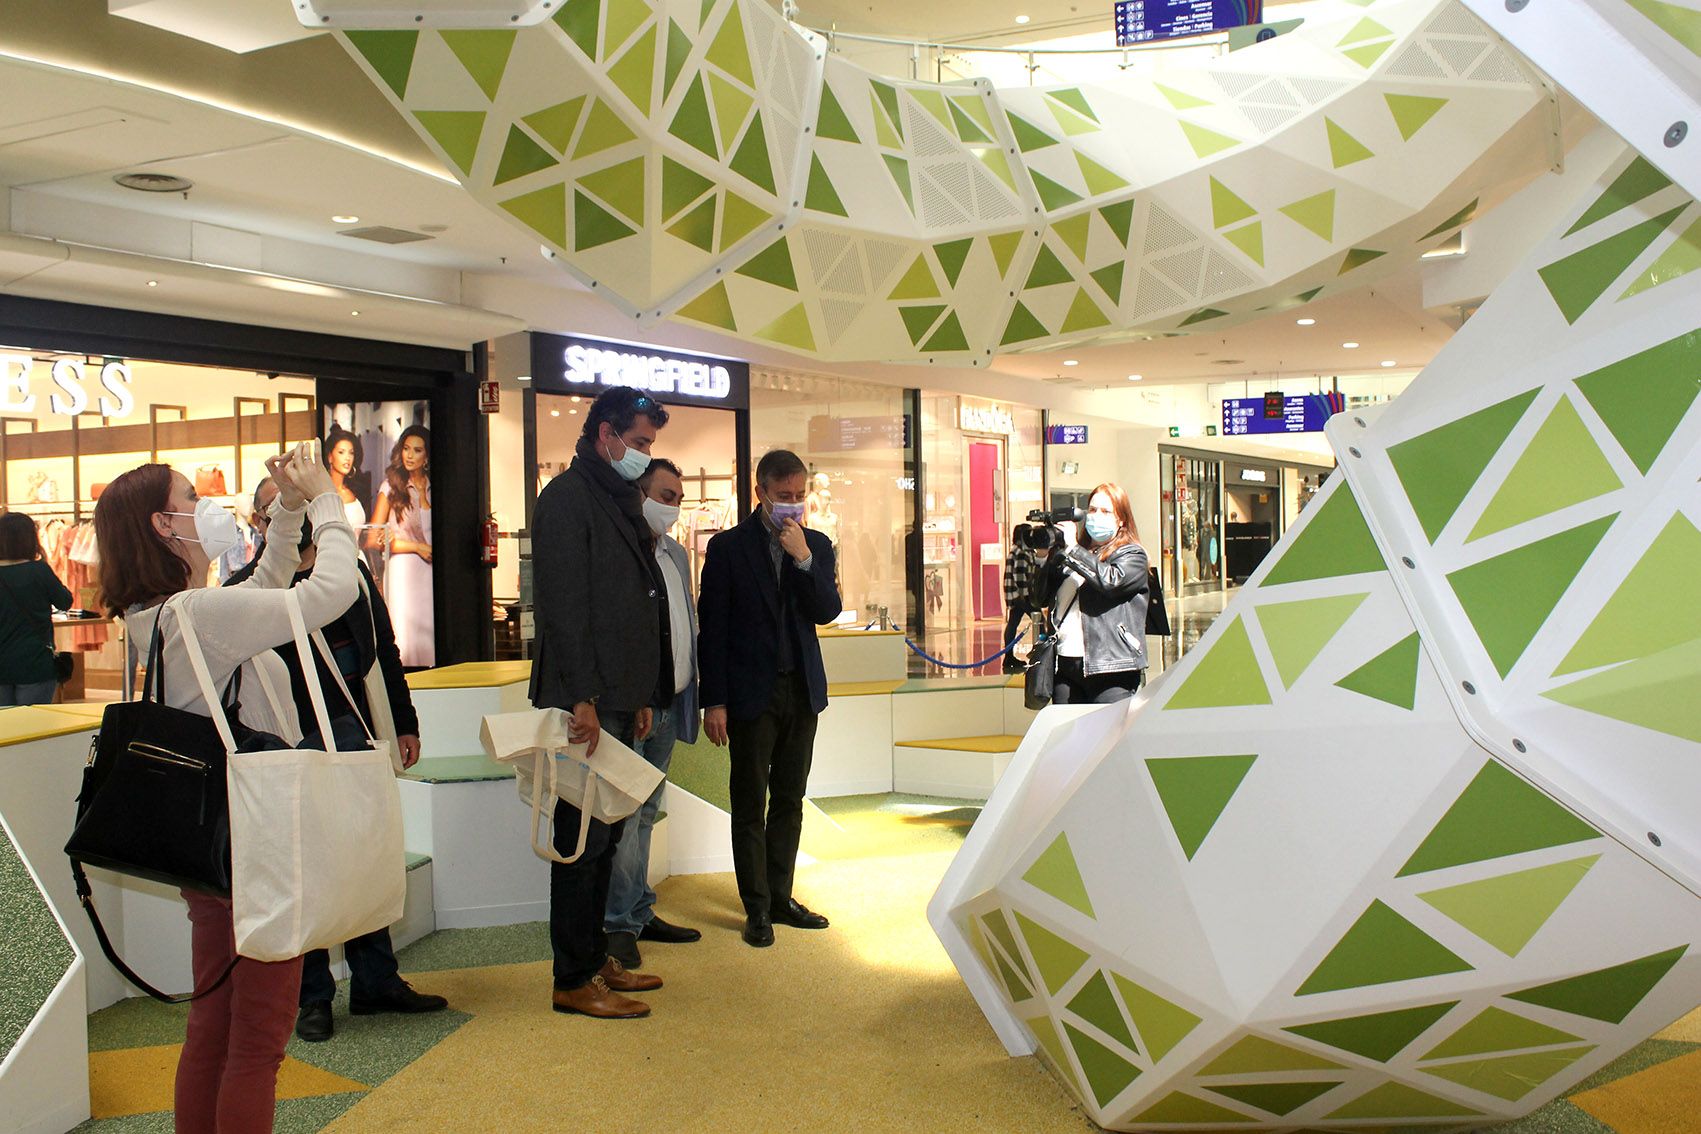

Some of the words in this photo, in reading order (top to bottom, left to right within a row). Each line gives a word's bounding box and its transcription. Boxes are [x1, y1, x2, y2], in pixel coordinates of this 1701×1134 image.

[1195, 22, 1213, 30] Parking
[0, 354, 134, 418] ESS
[564, 344, 731, 399] SPRINGFIELD
